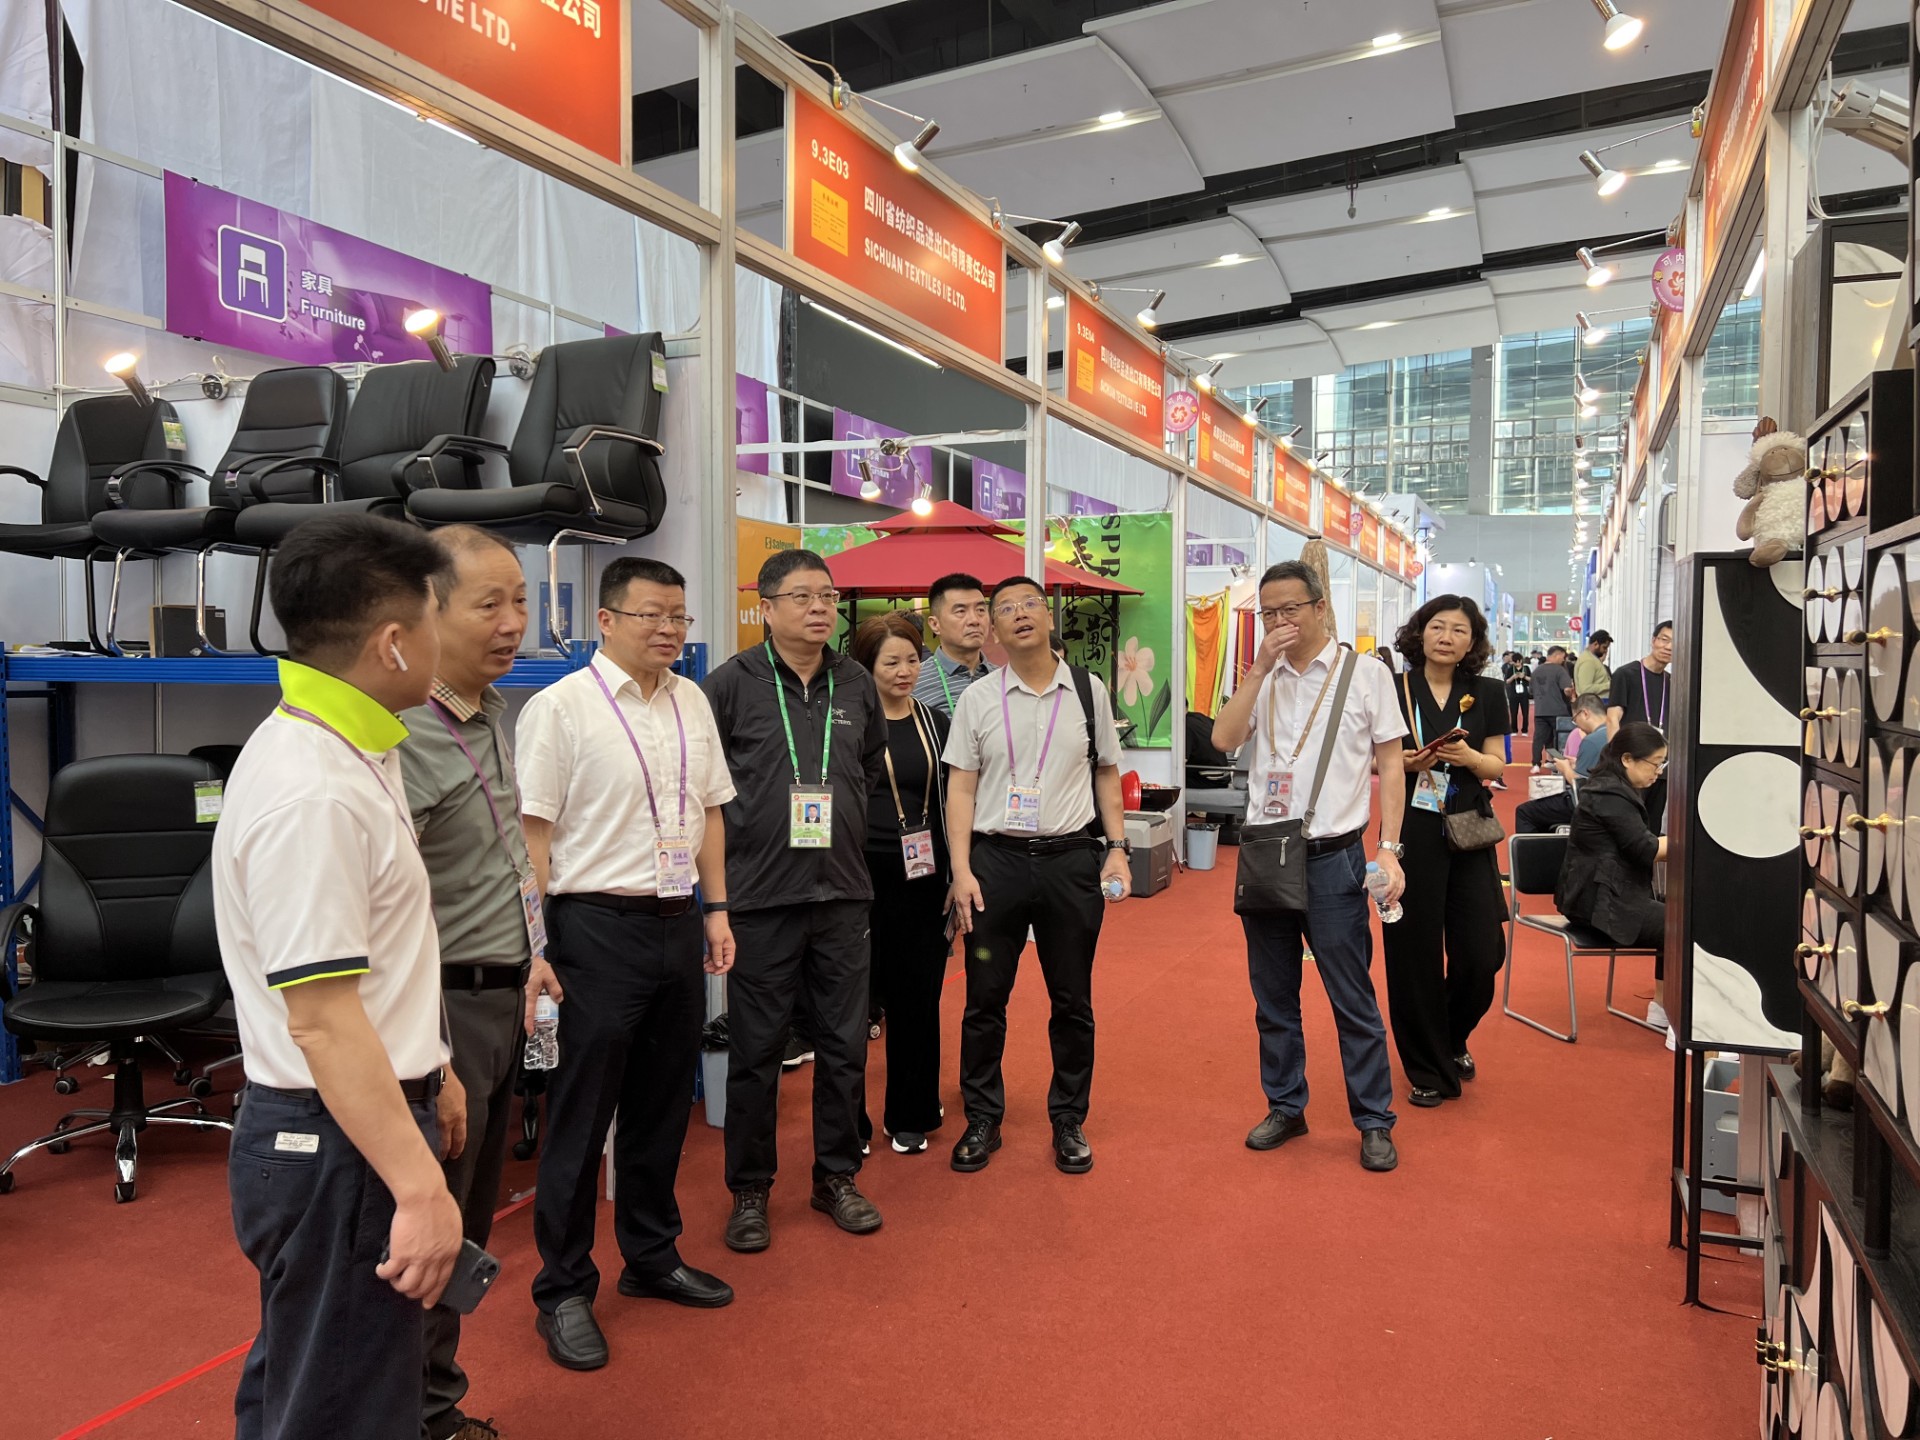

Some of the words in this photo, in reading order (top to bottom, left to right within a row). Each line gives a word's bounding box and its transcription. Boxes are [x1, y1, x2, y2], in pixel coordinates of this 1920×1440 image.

[471, 2, 516, 52] LTD.
[811, 139, 849, 180] 9.3E03
[864, 185, 996, 293] 四川省纺织品进出口有限责任公司
[301, 271, 333, 297] 家具
[864, 237, 903, 276] SICHUAN
[904, 261, 942, 297] TEXTILES
[952, 287, 967, 312] LTD.
[301, 298, 366, 331] Furniture
[740, 604, 765, 625] uti
[1541, 596, 1552, 609] E
